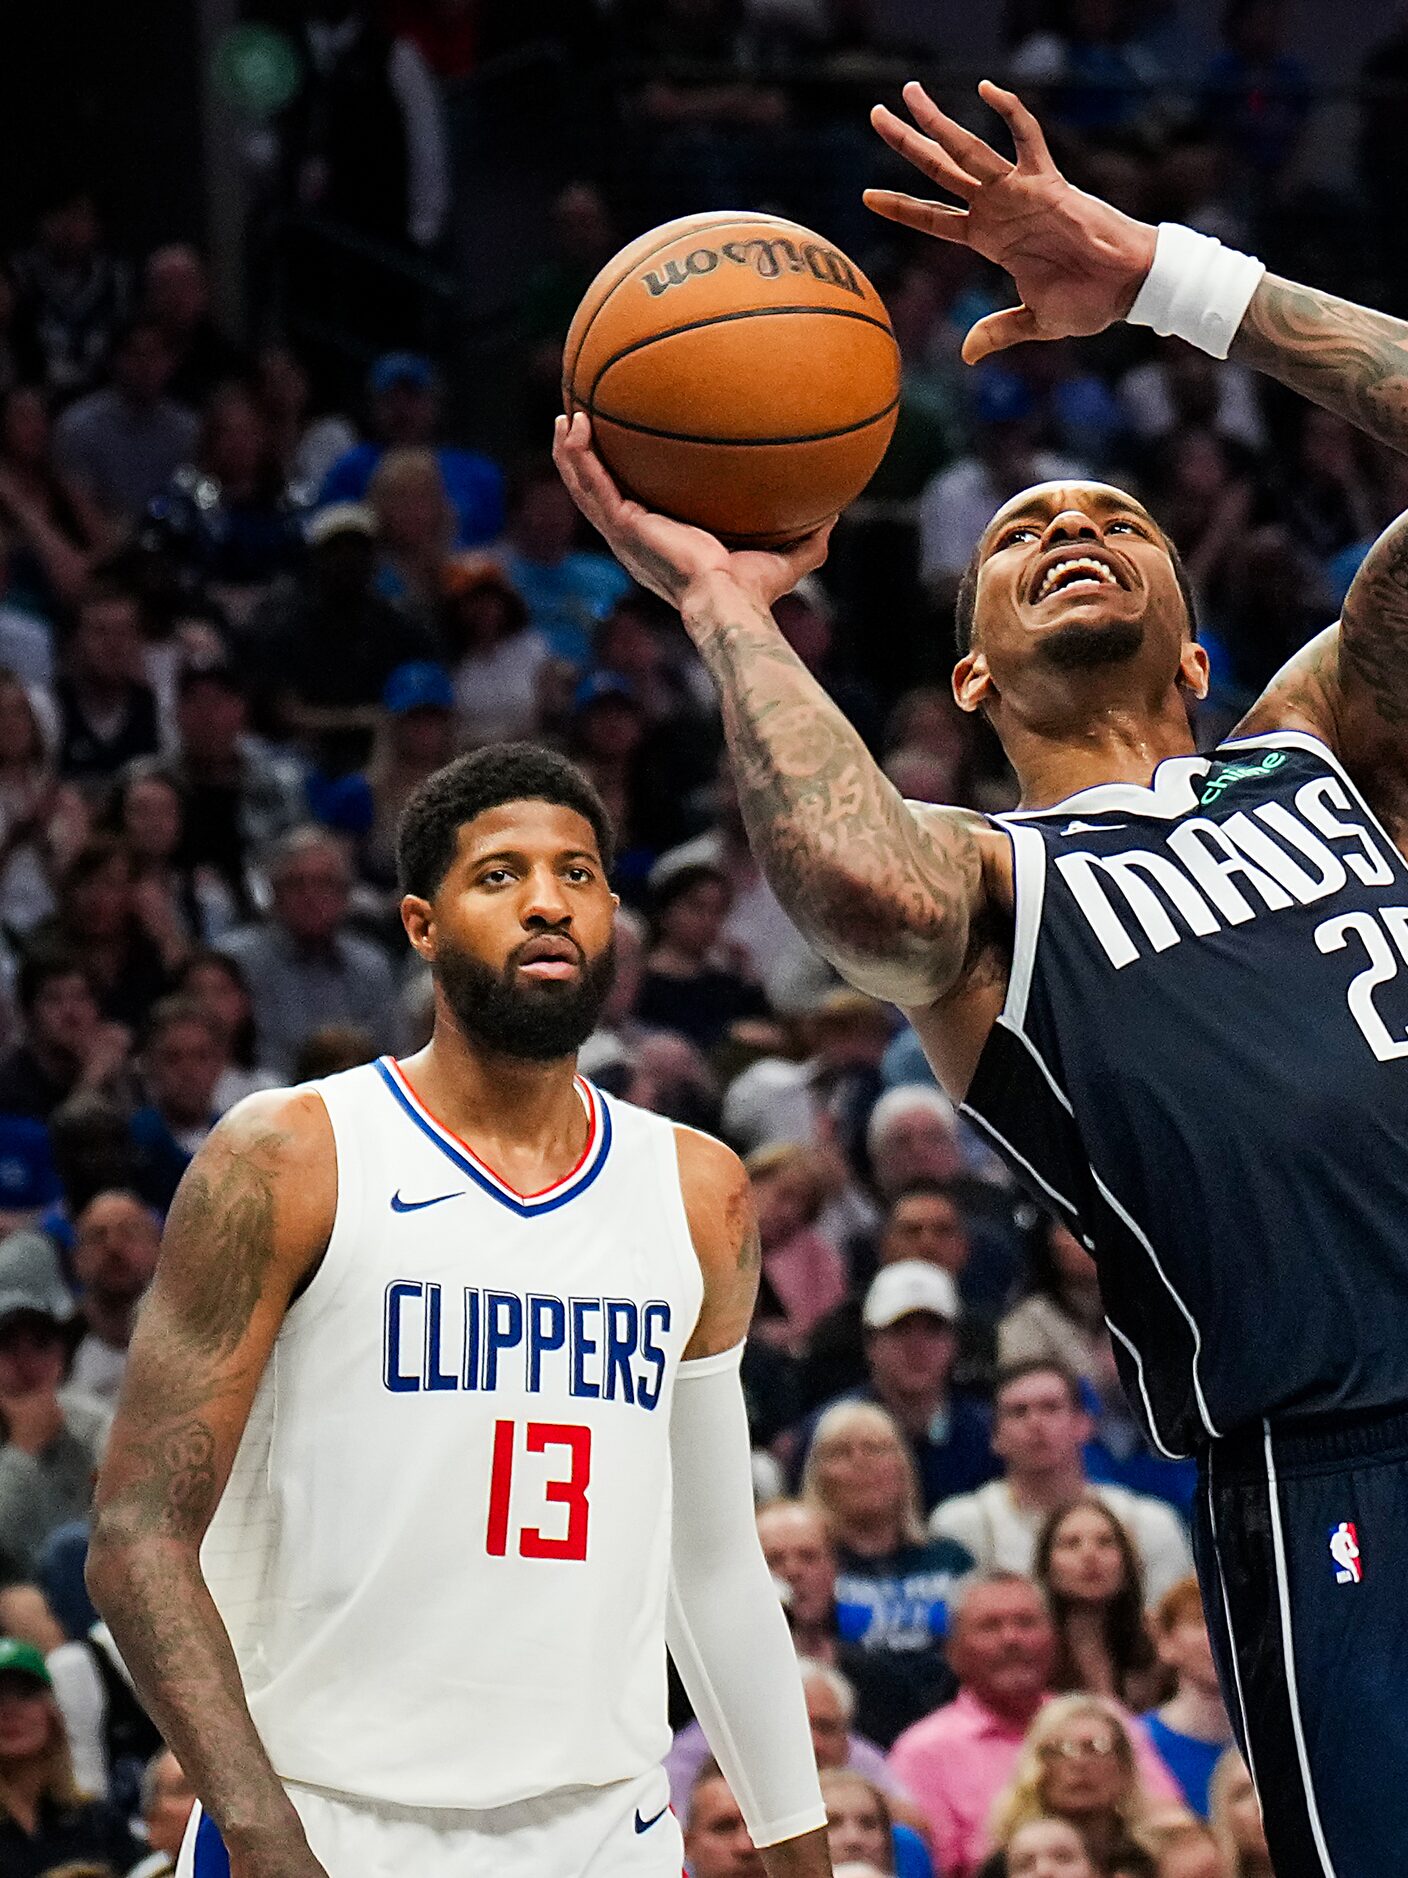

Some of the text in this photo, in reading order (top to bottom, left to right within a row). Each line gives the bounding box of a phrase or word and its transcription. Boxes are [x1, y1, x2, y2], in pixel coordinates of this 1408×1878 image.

[642, 239, 865, 298] Wilson
[1054, 776, 1395, 970] MAVS
[382, 1279, 671, 1411] CLIPPERS
[486, 1420, 592, 1561] 13
